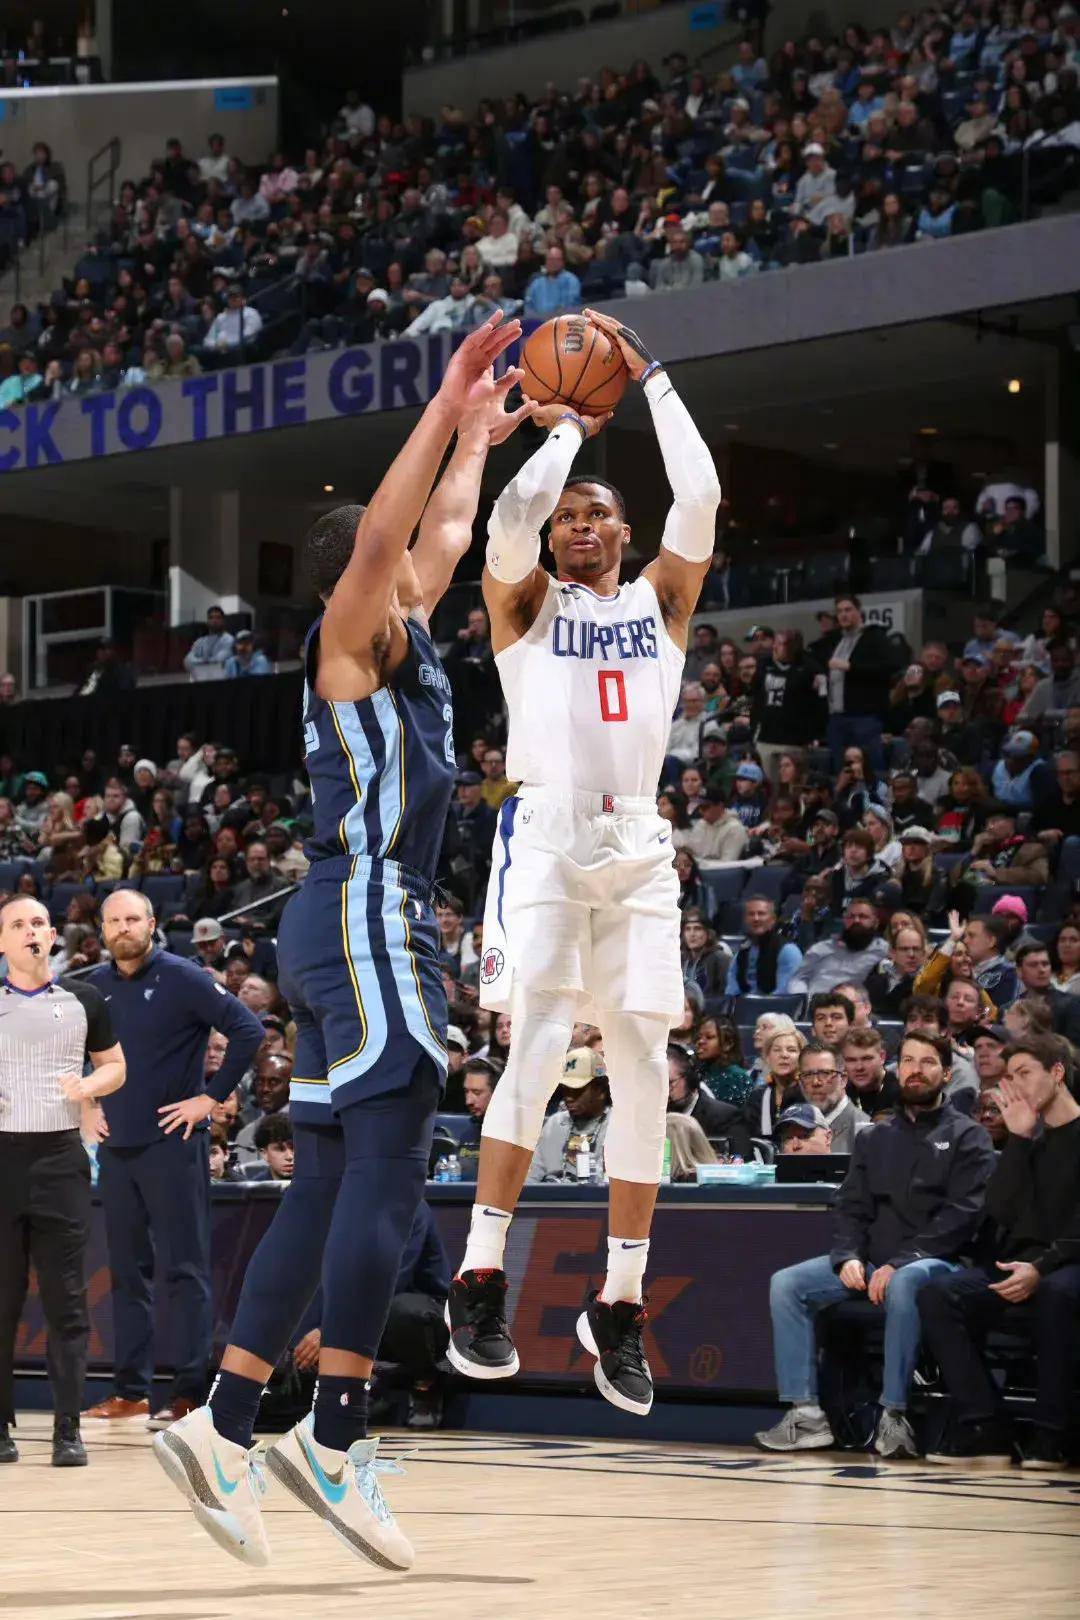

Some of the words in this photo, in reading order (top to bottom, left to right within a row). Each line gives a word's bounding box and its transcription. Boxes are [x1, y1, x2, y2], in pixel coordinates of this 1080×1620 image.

[82, 385, 162, 457] TO
[182, 359, 307, 442] THE
[553, 615, 659, 660] CLIPPERS
[598, 670, 628, 721] 0
